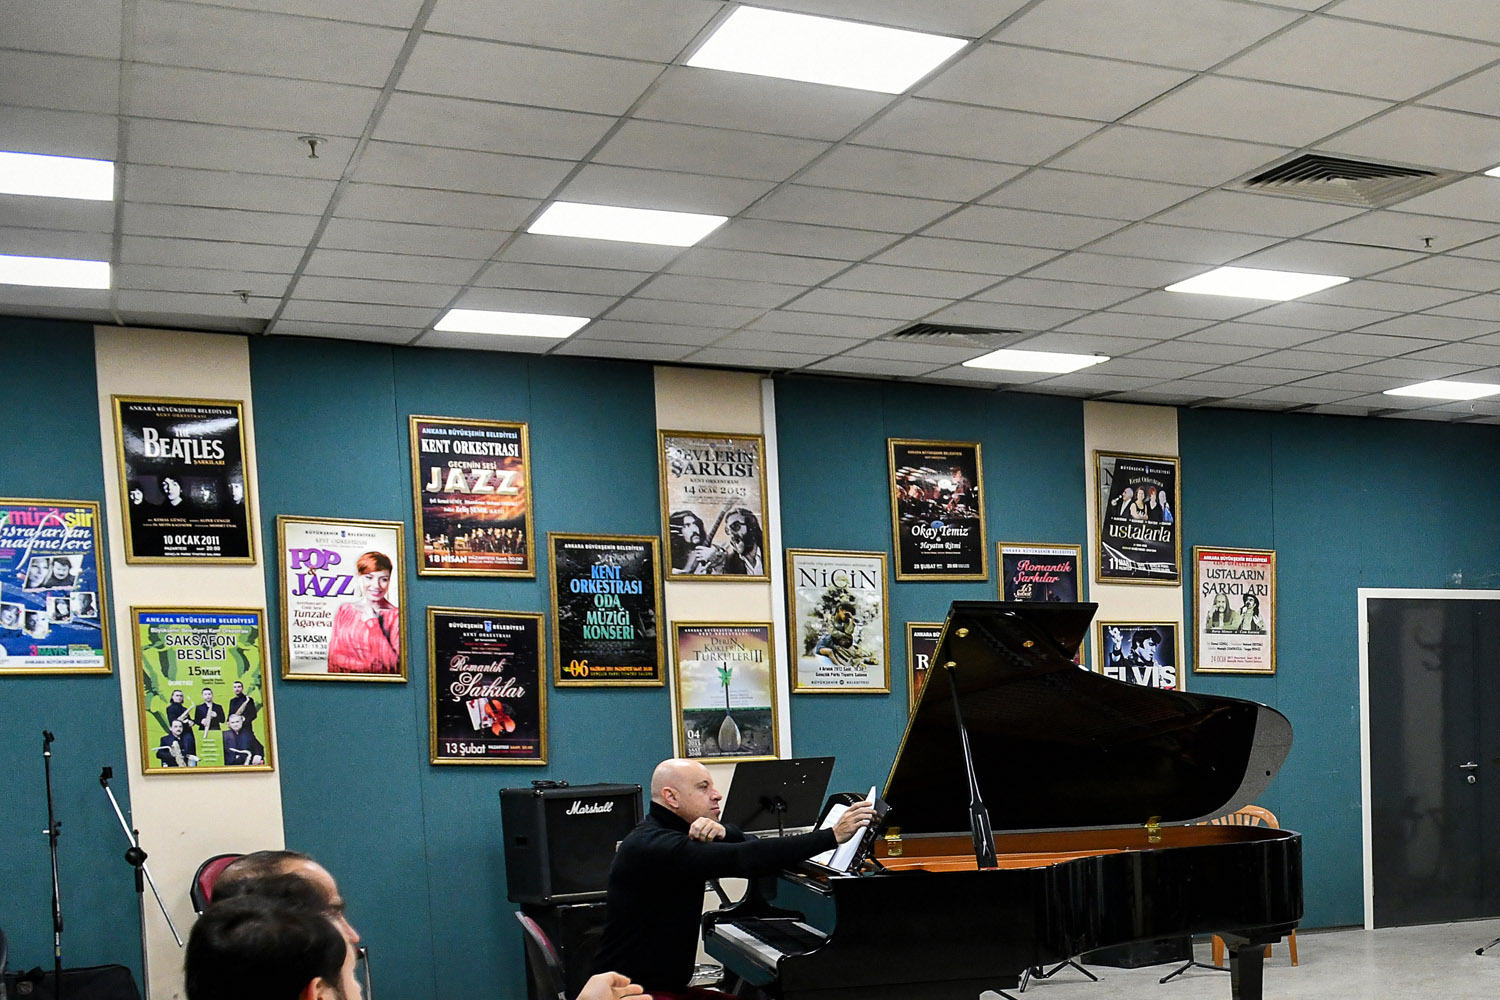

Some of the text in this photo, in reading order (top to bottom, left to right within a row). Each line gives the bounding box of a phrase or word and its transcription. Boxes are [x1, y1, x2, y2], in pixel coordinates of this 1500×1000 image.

[157, 406, 196, 414] BÜYÜKŞEHİR
[422, 427, 447, 435] ANKARA
[448, 427, 485, 437] BÜYÜKŞEHİR
[142, 427, 225, 464] BEATLES
[421, 439, 519, 457] KENT ORKESTRASI
[448, 460, 481, 469] GECENİN
[426, 466, 519, 496] JAZZ
[684, 486, 696, 495] 14
[911, 523, 969, 539] Okay Temiz
[1109, 524, 1171, 542] ustalarla
[163, 535, 220, 545] 10 OCAK 2011
[289, 547, 342, 571] POP
[441, 554, 467, 563] NİSAN
[591, 565, 621, 579] KENT
[1017, 560, 1072, 572] Romantik
[1013, 571, 1060, 584] Şarkılar
[1207, 568, 1265, 580] USTALARIN
[292, 572, 354, 598] JAZZ
[570, 578, 643, 594] ORKESTRASI
[1202, 582, 1268, 597] ŞARKILARI
[594, 594, 621, 608] ODA
[176, 616, 216, 624] BÜYÜKŞEHİR
[293, 609, 331, 618] Tunzale
[586, 607, 630, 625] MÜZİĞİ
[292, 618, 332, 628] Agayeva
[293, 635, 327, 643] 25 KASIM
[583, 625, 634, 639] KONSERİ
[165, 635, 236, 646] SAKSAFON
[29, 644, 38, 656] 3
[177, 647, 226, 662] BEŞLİSİ
[450, 655, 506, 672] Romantik
[189, 666, 221, 676] 15 Mart
[450, 672, 526, 702] Şarkılar
[687, 729, 700, 739] 04
[445, 742, 458, 753] 13
[459, 742, 486, 756] Şubat
[566, 801, 614, 815] Marshall
